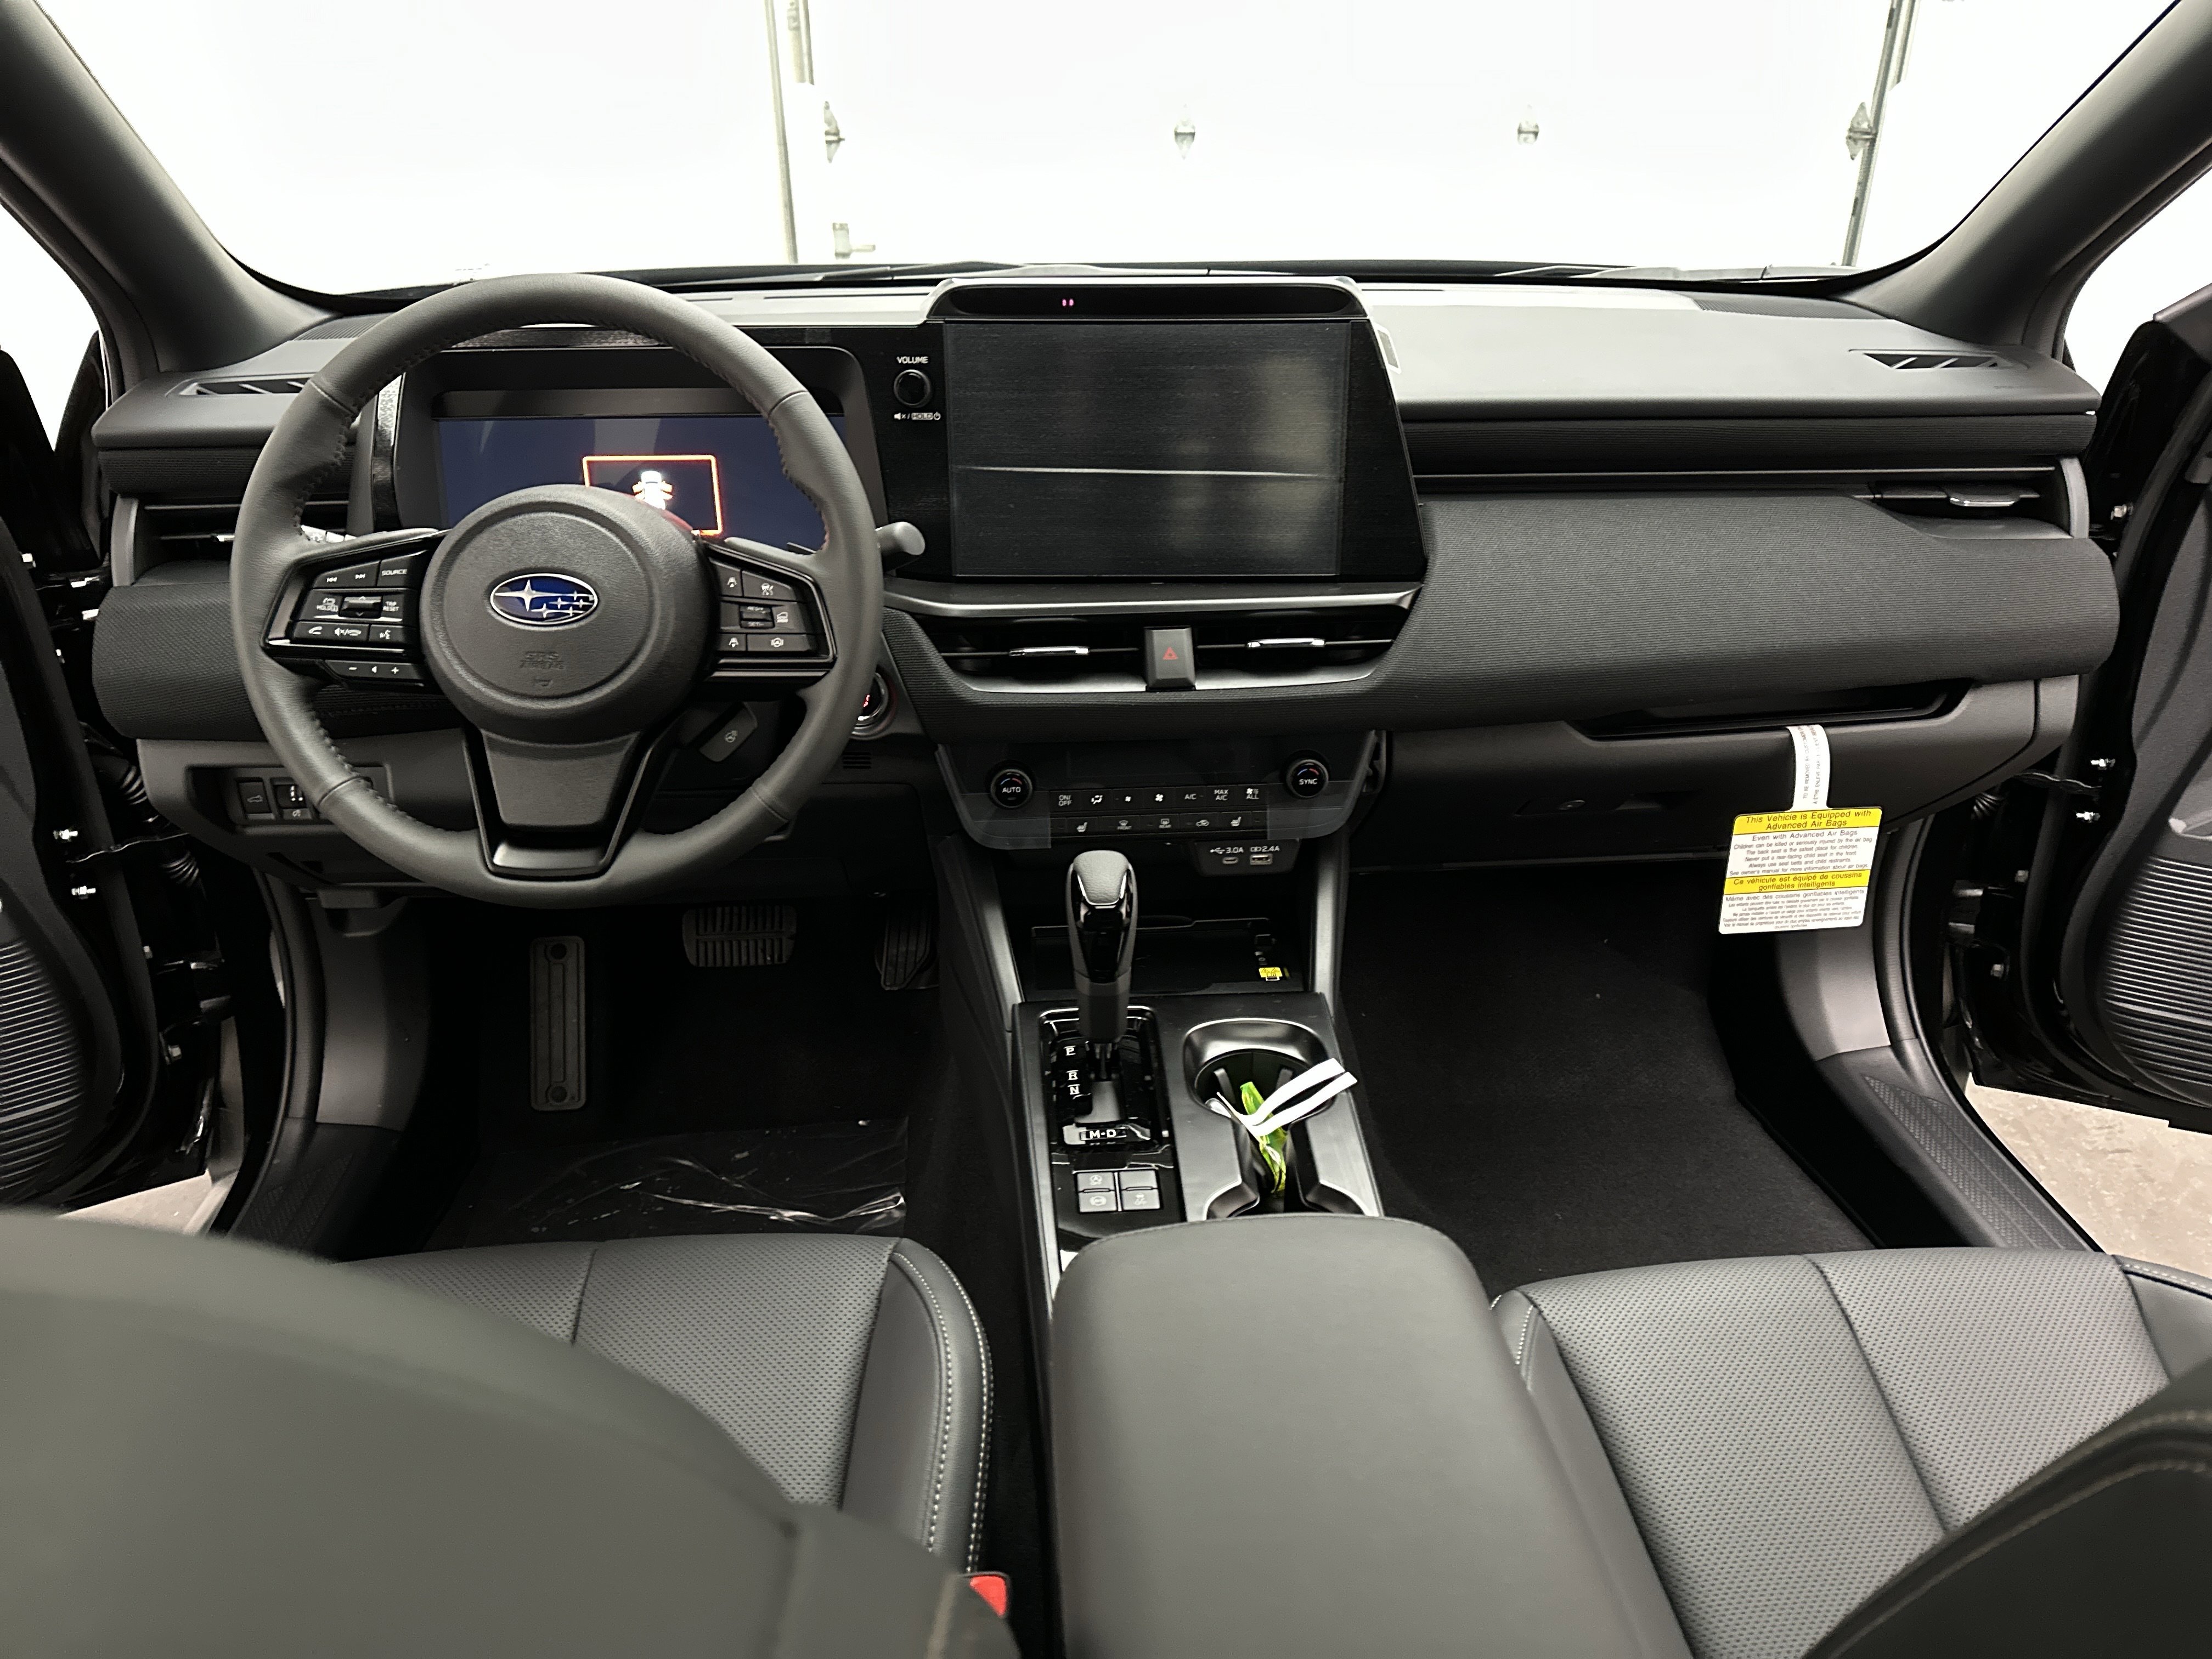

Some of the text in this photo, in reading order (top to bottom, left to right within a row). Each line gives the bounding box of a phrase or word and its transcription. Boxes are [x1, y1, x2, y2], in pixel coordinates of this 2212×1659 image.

[1811, 811, 1851, 820] Equipped
[1765, 821, 1807, 830] Advanced
[1826, 819, 1847, 828] Bags
[1758, 883, 1795, 892] gonflables
[1065, 1047, 1076, 1056] P
[1068, 1071, 1078, 1080] R
[1070, 1086, 1080, 1094] N
